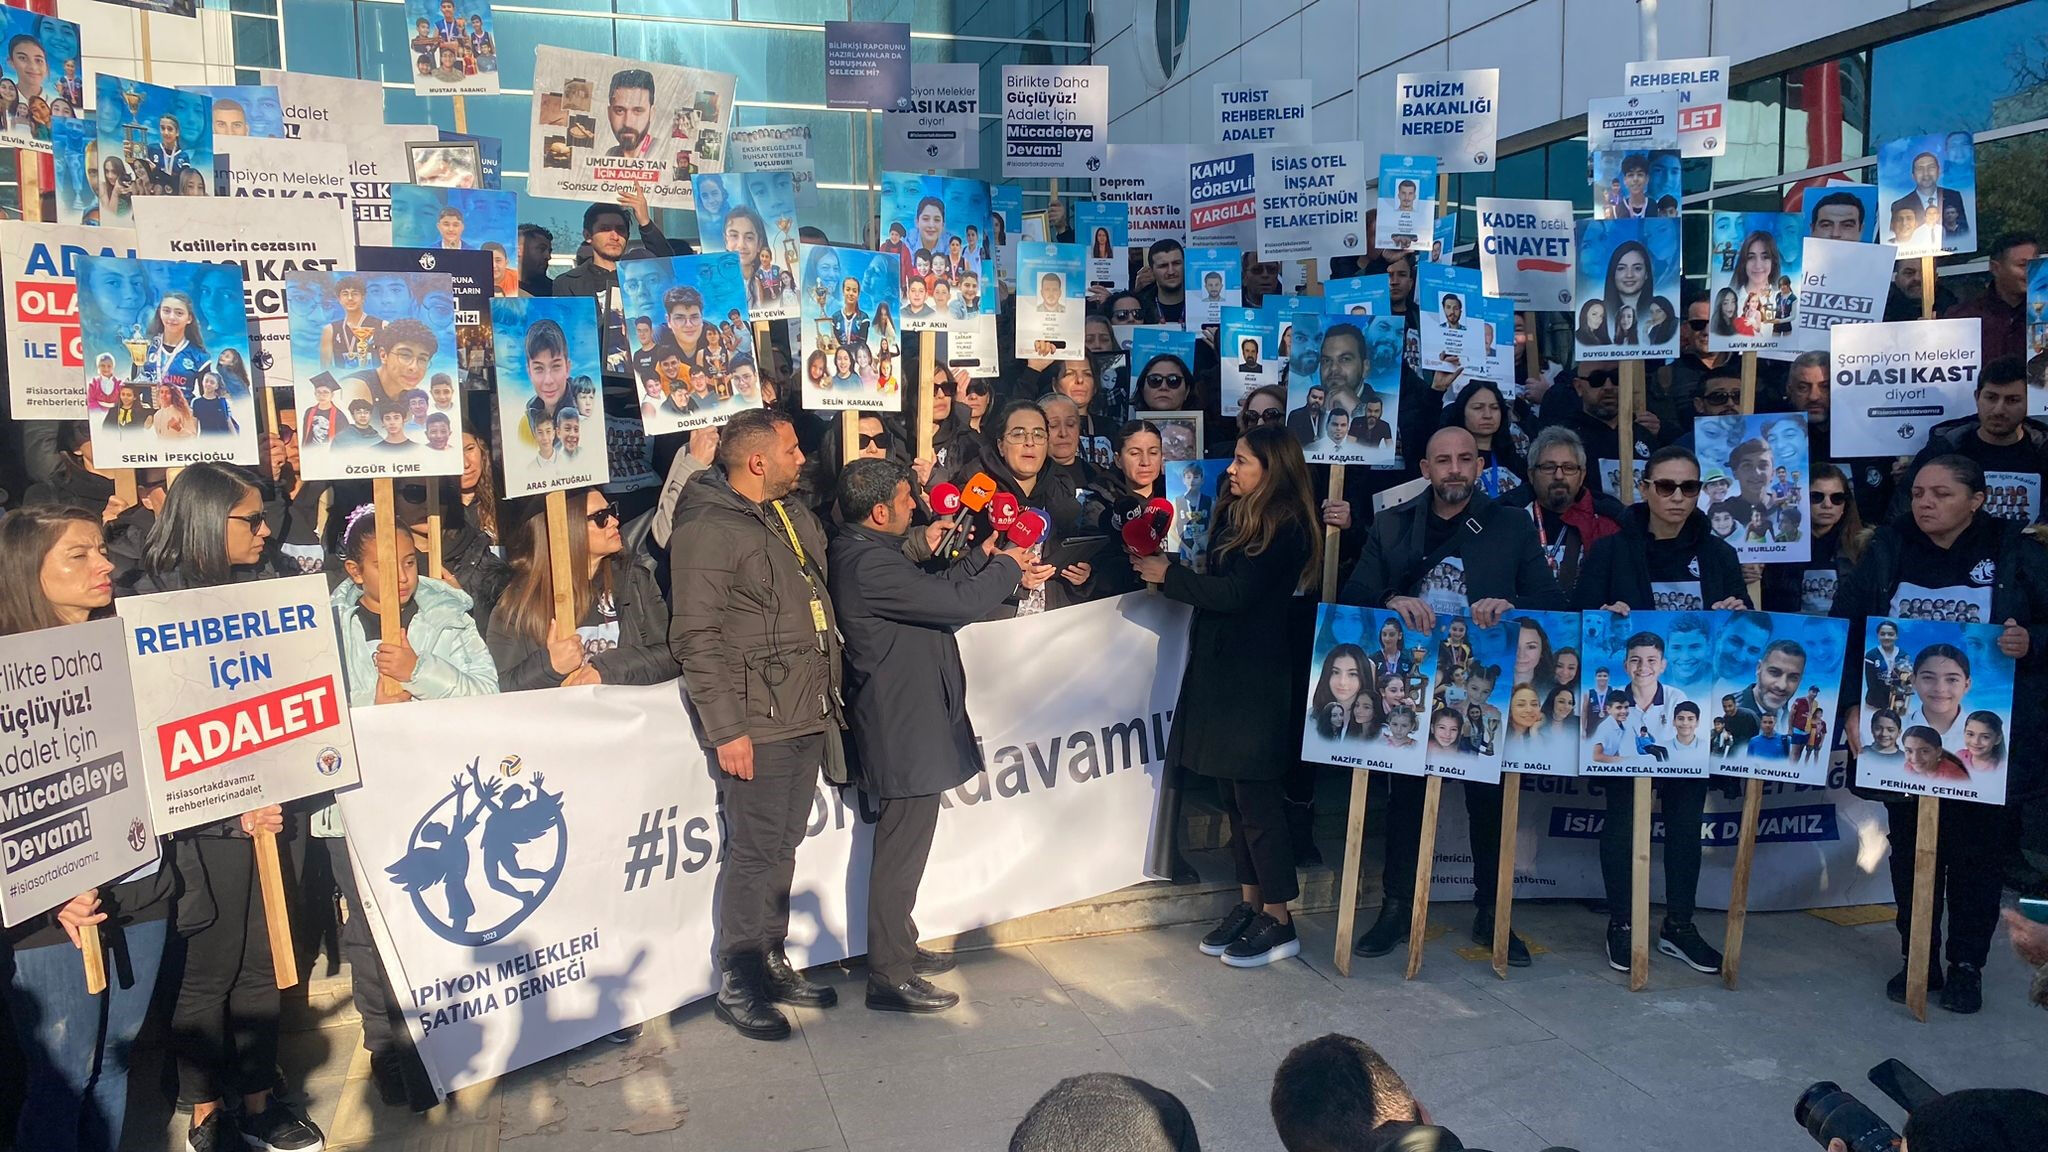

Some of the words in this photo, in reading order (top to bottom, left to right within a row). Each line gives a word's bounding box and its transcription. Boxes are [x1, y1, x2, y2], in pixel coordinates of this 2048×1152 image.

[829, 60, 877, 68] DURUŞMAYA
[1006, 75, 1050, 88] Birlikte
[1053, 76, 1090, 89] Daha
[1630, 70, 1720, 88] REHBERLER
[937, 86, 976, 97] Melekler
[1221, 88, 1269, 104] TURİST
[1402, 81, 1464, 98] TURİZM
[1006, 92, 1077, 106] Güçlüyüz!
[281, 105, 329, 122] dalet
[938, 100, 978, 114] KAST
[1222, 104, 1304, 123] REHBERLERİ
[1402, 97, 1491, 118] BAKANLIĞI
[1608, 110, 1632, 118] KUSUR
[918, 116, 945, 128] diyor!
[1006, 108, 1050, 121] Adalet
[1053, 108, 1077, 123] İçin
[1678, 108, 1717, 130] LET
[1006, 126, 1092, 142] Mücadeleye
[1222, 127, 1275, 142] ADALET
[1402, 120, 1465, 136] NEREDE
[1615, 128, 1651, 137] NEREDE?
[2, 136, 26, 146] ELVİN
[1006, 142, 1062, 156] Devam!
[481, 158, 498, 166] UNU
[586, 157, 616, 167] UMUT
[618, 158, 644, 169] ULAŞ
[647, 160, 667, 170] TAN
[1272, 156, 1308, 172] İSİAS
[1311, 155, 1346, 168] OTEL
[598, 168, 620, 180] İÇİN
[620, 170, 654, 180] ADALET
[1192, 160, 1236, 181] KAMU
[283, 172, 344, 186] Melekler
[1100, 178, 1145, 189] Deprem
[1284, 174, 1335, 191] İNŞAAT
[1100, 192, 1152, 201] Sanıkları
[1263, 190, 1358, 210] SEKTÖRÜNÜN
[1135, 206, 1164, 215] KAST
[1166, 204, 1180, 215] ile
[1128, 220, 1186, 230] GILANMALI
[1264, 209, 1358, 229] FELAKETİDİR!
[1482, 212, 1536, 229] KADER
[1540, 218, 1568, 230] DEĞİL
[170, 239, 248, 252] Katillerin
[250, 240, 318, 252] cezasını
[452, 276, 474, 284] RUNA
[1802, 270, 1826, 288] let
[1820, 294, 1873, 314] KAST
[455, 312, 478, 324] NİZ!
[764, 310, 786, 318] ÇEVİK
[24, 338, 58, 359] İLE
[1582, 350, 1608, 358] DUYGU
[1610, 350, 1640, 358] BOLSOY
[1837, 352, 1910, 368] Şampiyon
[1914, 349, 1976, 362] Melekler
[1836, 368, 1906, 386] OLASI
[1911, 365, 1978, 382] KAST
[26, 386, 87, 396] #isiasortakd
[1885, 387, 1926, 402] diyor!
[26, 398, 88, 407] #rehberleriç
[822, 398, 843, 407] SELİN
[847, 399, 884, 408] KARAKAYA
[677, 417, 708, 428] DORUK
[122, 452, 158, 464] SERİN
[165, 452, 234, 463] İPEKÇİOĞLU
[1312, 452, 1325, 461] ALİ
[346, 463, 386, 474] ÖZGÜR
[392, 462, 420, 475] İÇME
[526, 480, 548, 491] ARAS
[550, 474, 592, 488] AKTUĞRALI
[1016, 521, 1032, 536] DH
[134, 604, 318, 656] REHBERLER
[51, 650, 104, 681] Daha
[208, 651, 272, 691] İÇİN
[0, 686, 92, 739] üçlüyüz!
[170, 686, 327, 773] ADALET
[63, 727, 98, 763] İçin
[1330, 754, 1362, 766] NAZİFE
[1366, 758, 1393, 769] DAĞLI
[1524, 762, 1551, 770] DAĞLI
[1720, 763, 1749, 774] PAMİR
[1438, 766, 1466, 776] DAĞLI
[1586, 764, 1623, 774] ATAKAN
[1625, 765, 1654, 774] CELAL
[1656, 766, 1702, 775] KONUKLU
[166, 774, 256, 802] #isiasortakdavamız
[1880, 778, 1926, 792] PERİHAN
[1932, 786, 1978, 799] ÇETİNER
[168, 784, 262, 816] #rehberleriçinadalet
[4, 810, 92, 870] Devam!
[9, 850, 100, 898] #isiasortakdavamız
[482, 931, 498, 942] 2023
[412, 967, 490, 1008] PİYON
[496, 927, 600, 982] MELEKLERİ
[420, 992, 498, 1038] ŞATMA
[504, 956, 586, 1006] DERNEĞİ
